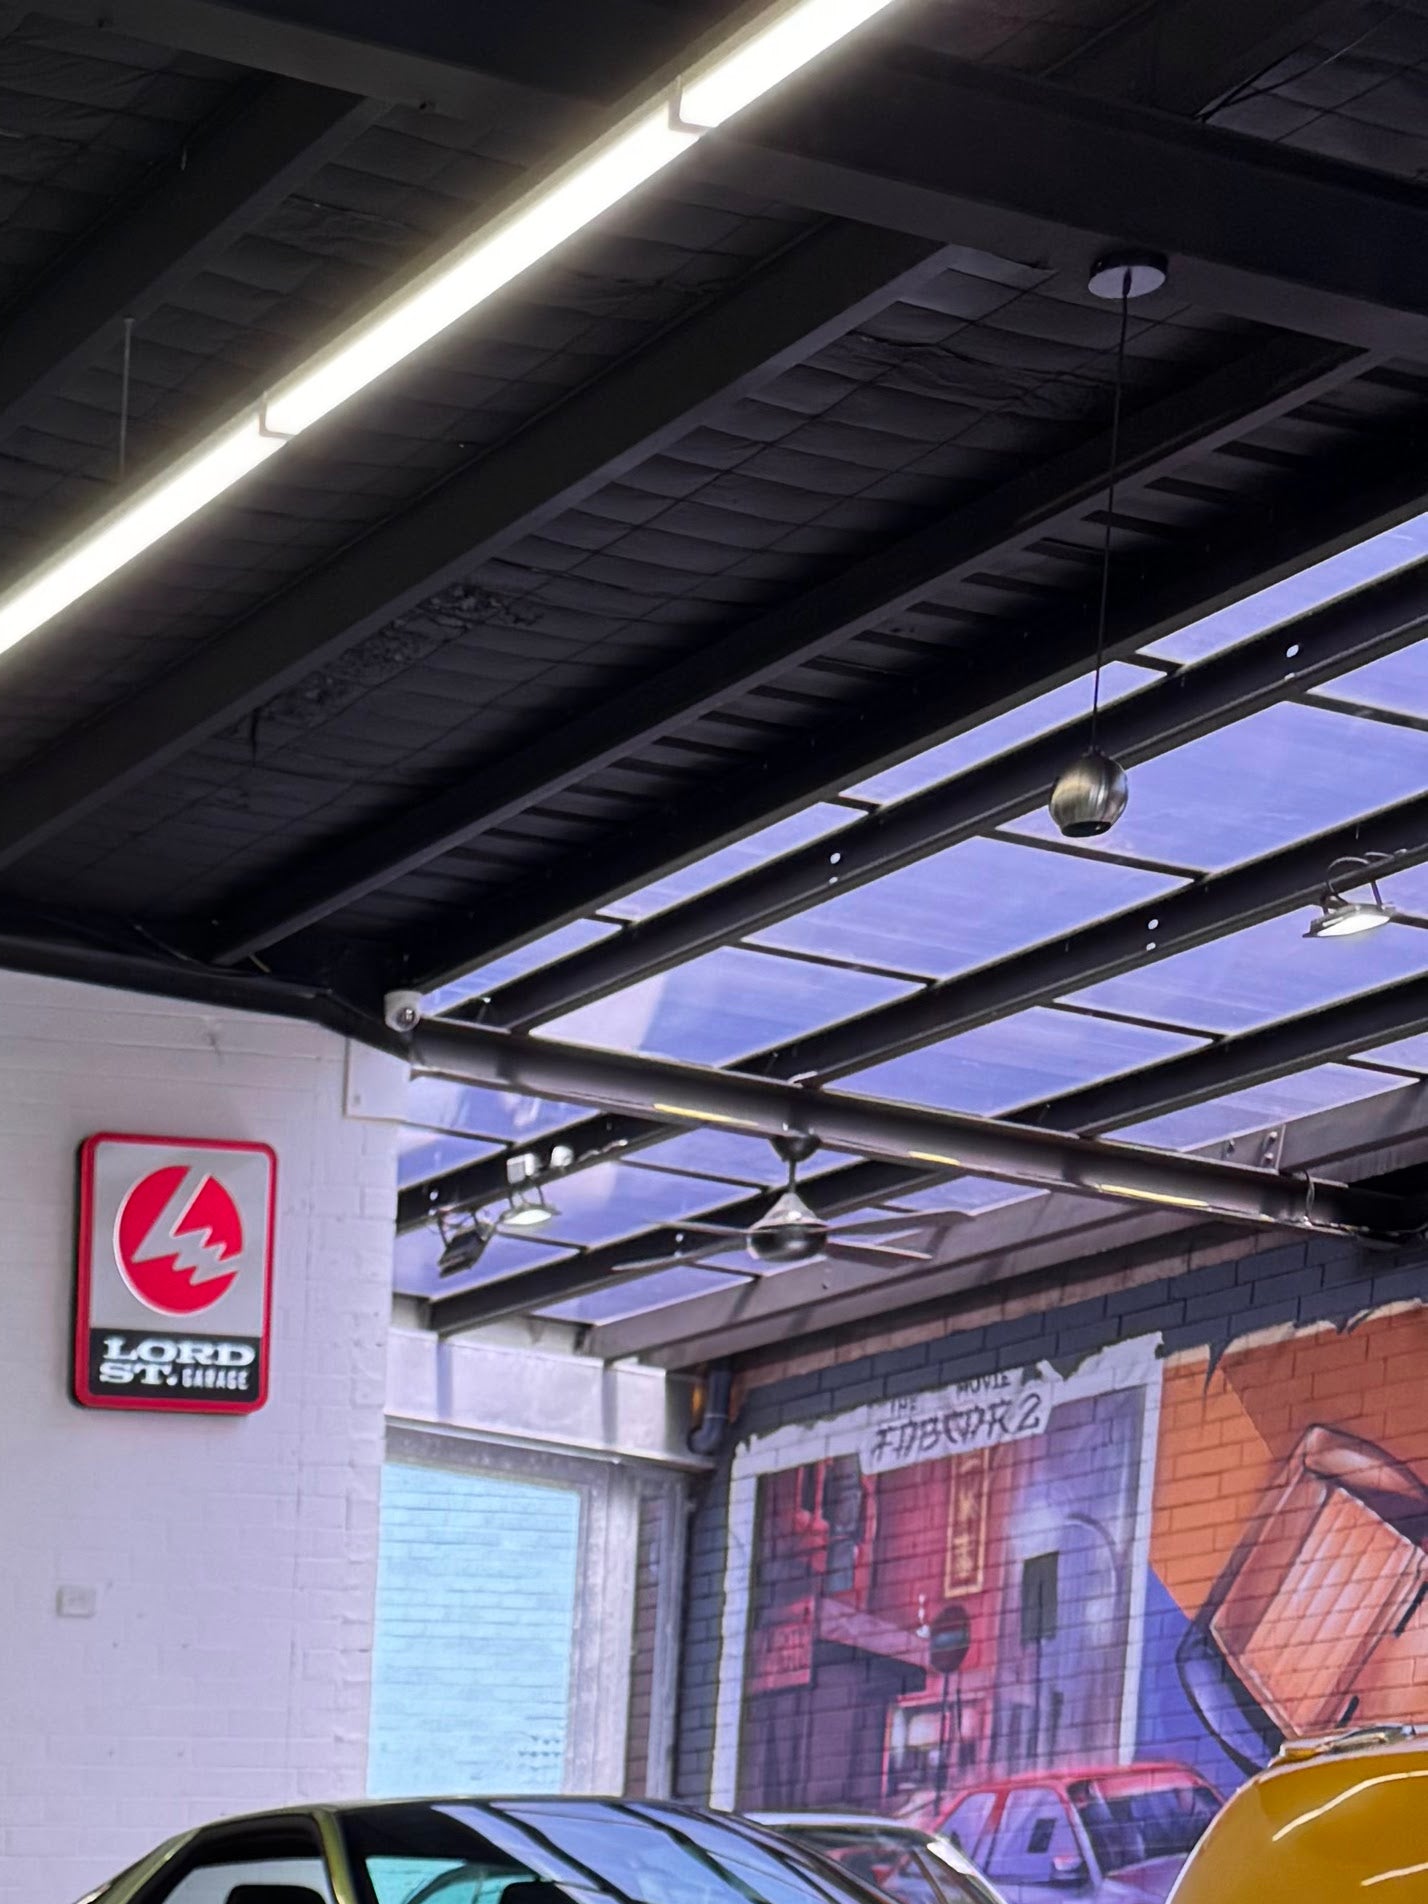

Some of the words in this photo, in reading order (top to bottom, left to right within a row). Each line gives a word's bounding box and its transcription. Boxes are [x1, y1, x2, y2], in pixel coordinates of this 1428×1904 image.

[102, 1335, 257, 1367] LORD
[98, 1360, 178, 1386] ST.
[181, 1366, 250, 1390] GARAGE
